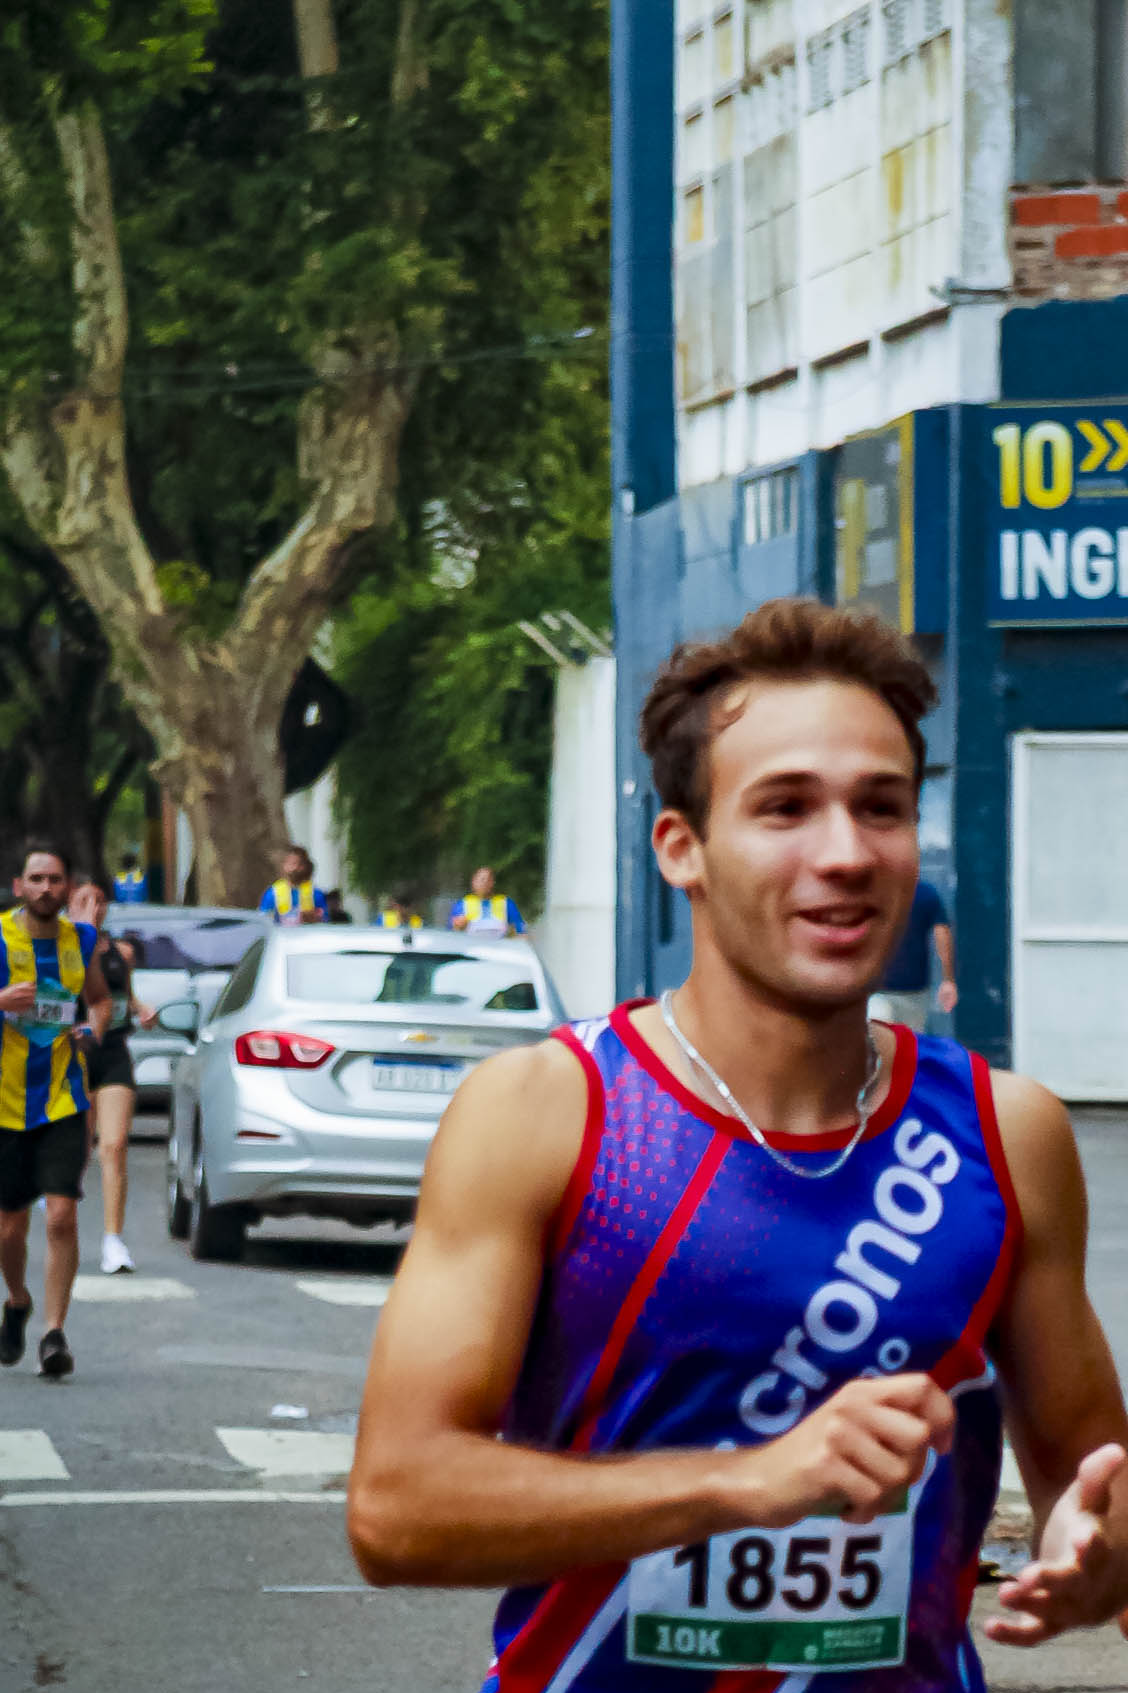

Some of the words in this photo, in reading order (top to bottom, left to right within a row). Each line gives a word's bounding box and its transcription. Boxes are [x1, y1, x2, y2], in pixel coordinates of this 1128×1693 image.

[992, 420, 1073, 509] 10
[739, 1118, 961, 1435] cronos
[673, 1537, 882, 1612] 1855
[656, 1625, 722, 1656] 10K
